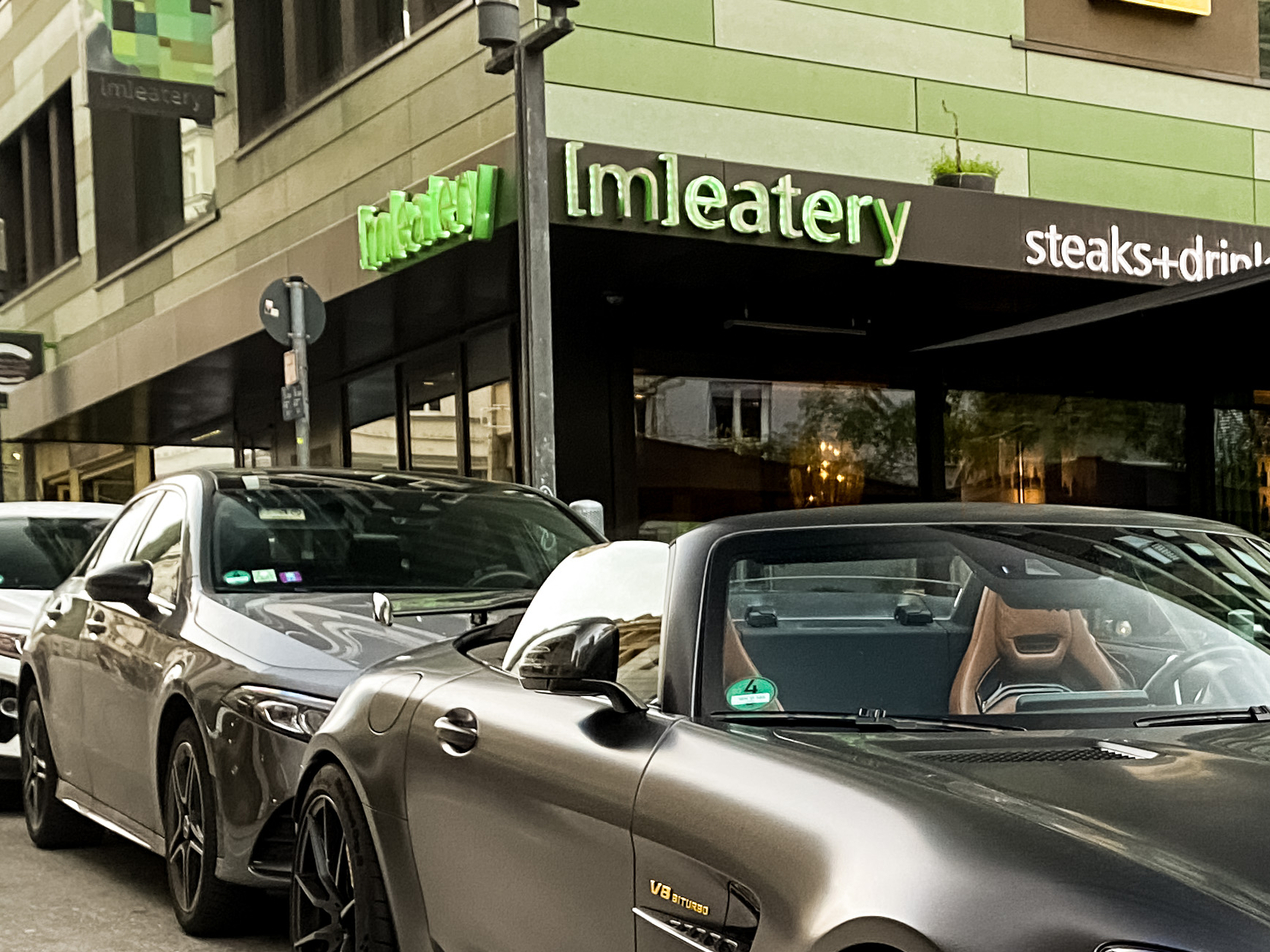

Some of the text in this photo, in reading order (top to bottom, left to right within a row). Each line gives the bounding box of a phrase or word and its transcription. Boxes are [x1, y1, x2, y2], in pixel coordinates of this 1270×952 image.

[565, 140, 911, 267] [m]eatery
[744, 679, 758, 694] 4
[650, 879, 709, 916] V8 BITURBO
